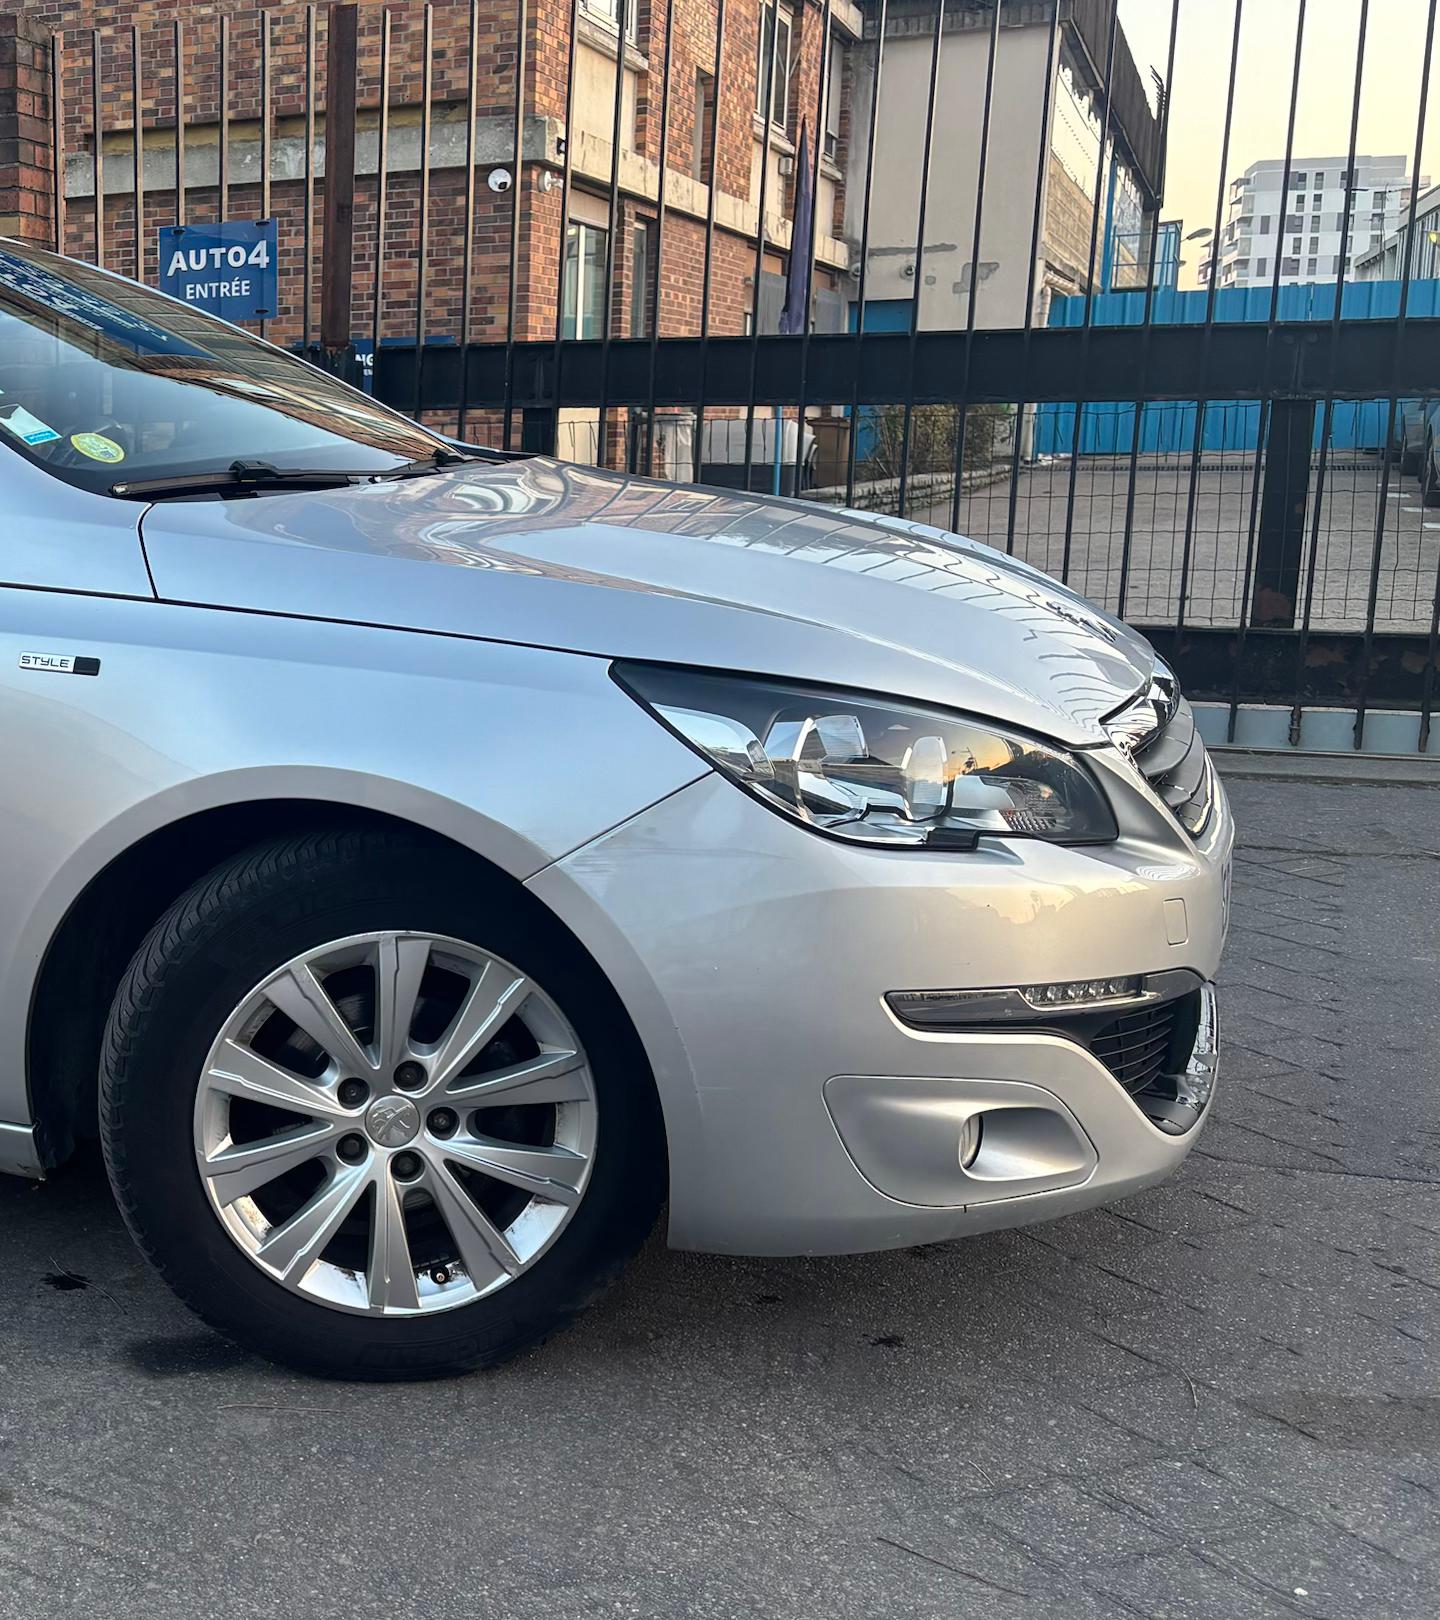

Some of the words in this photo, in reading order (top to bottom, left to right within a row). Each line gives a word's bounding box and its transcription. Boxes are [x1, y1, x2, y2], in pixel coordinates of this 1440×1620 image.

[166, 239, 270, 277] AUTO4
[185, 277, 251, 300] ENTRÉE
[21, 655, 70, 668] STYLE
